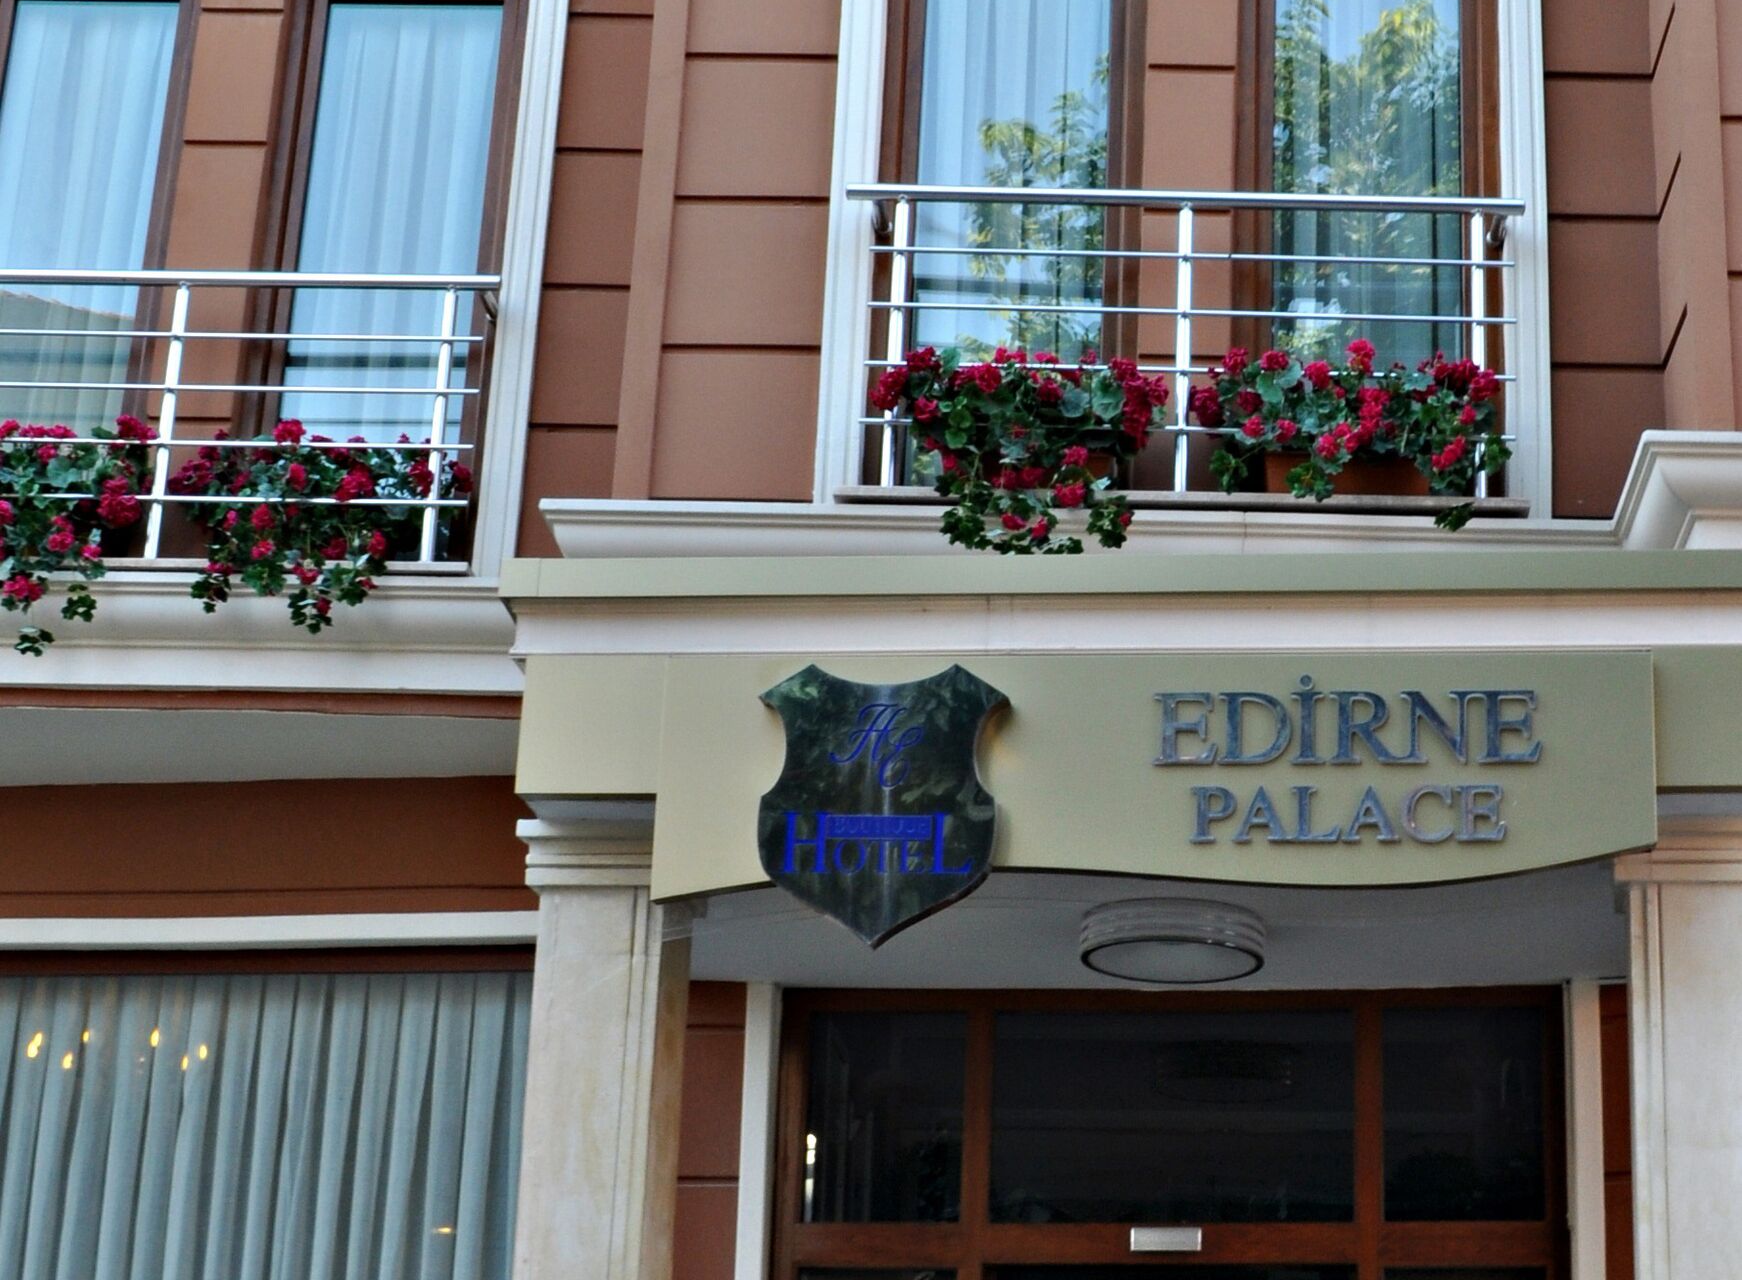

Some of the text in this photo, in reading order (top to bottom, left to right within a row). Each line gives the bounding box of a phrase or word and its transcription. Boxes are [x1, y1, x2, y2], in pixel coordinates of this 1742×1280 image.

[1153, 674, 1543, 766] EDİRNE
[782, 810, 974, 874] HOTEL
[1189, 784, 1507, 844] PALACE
